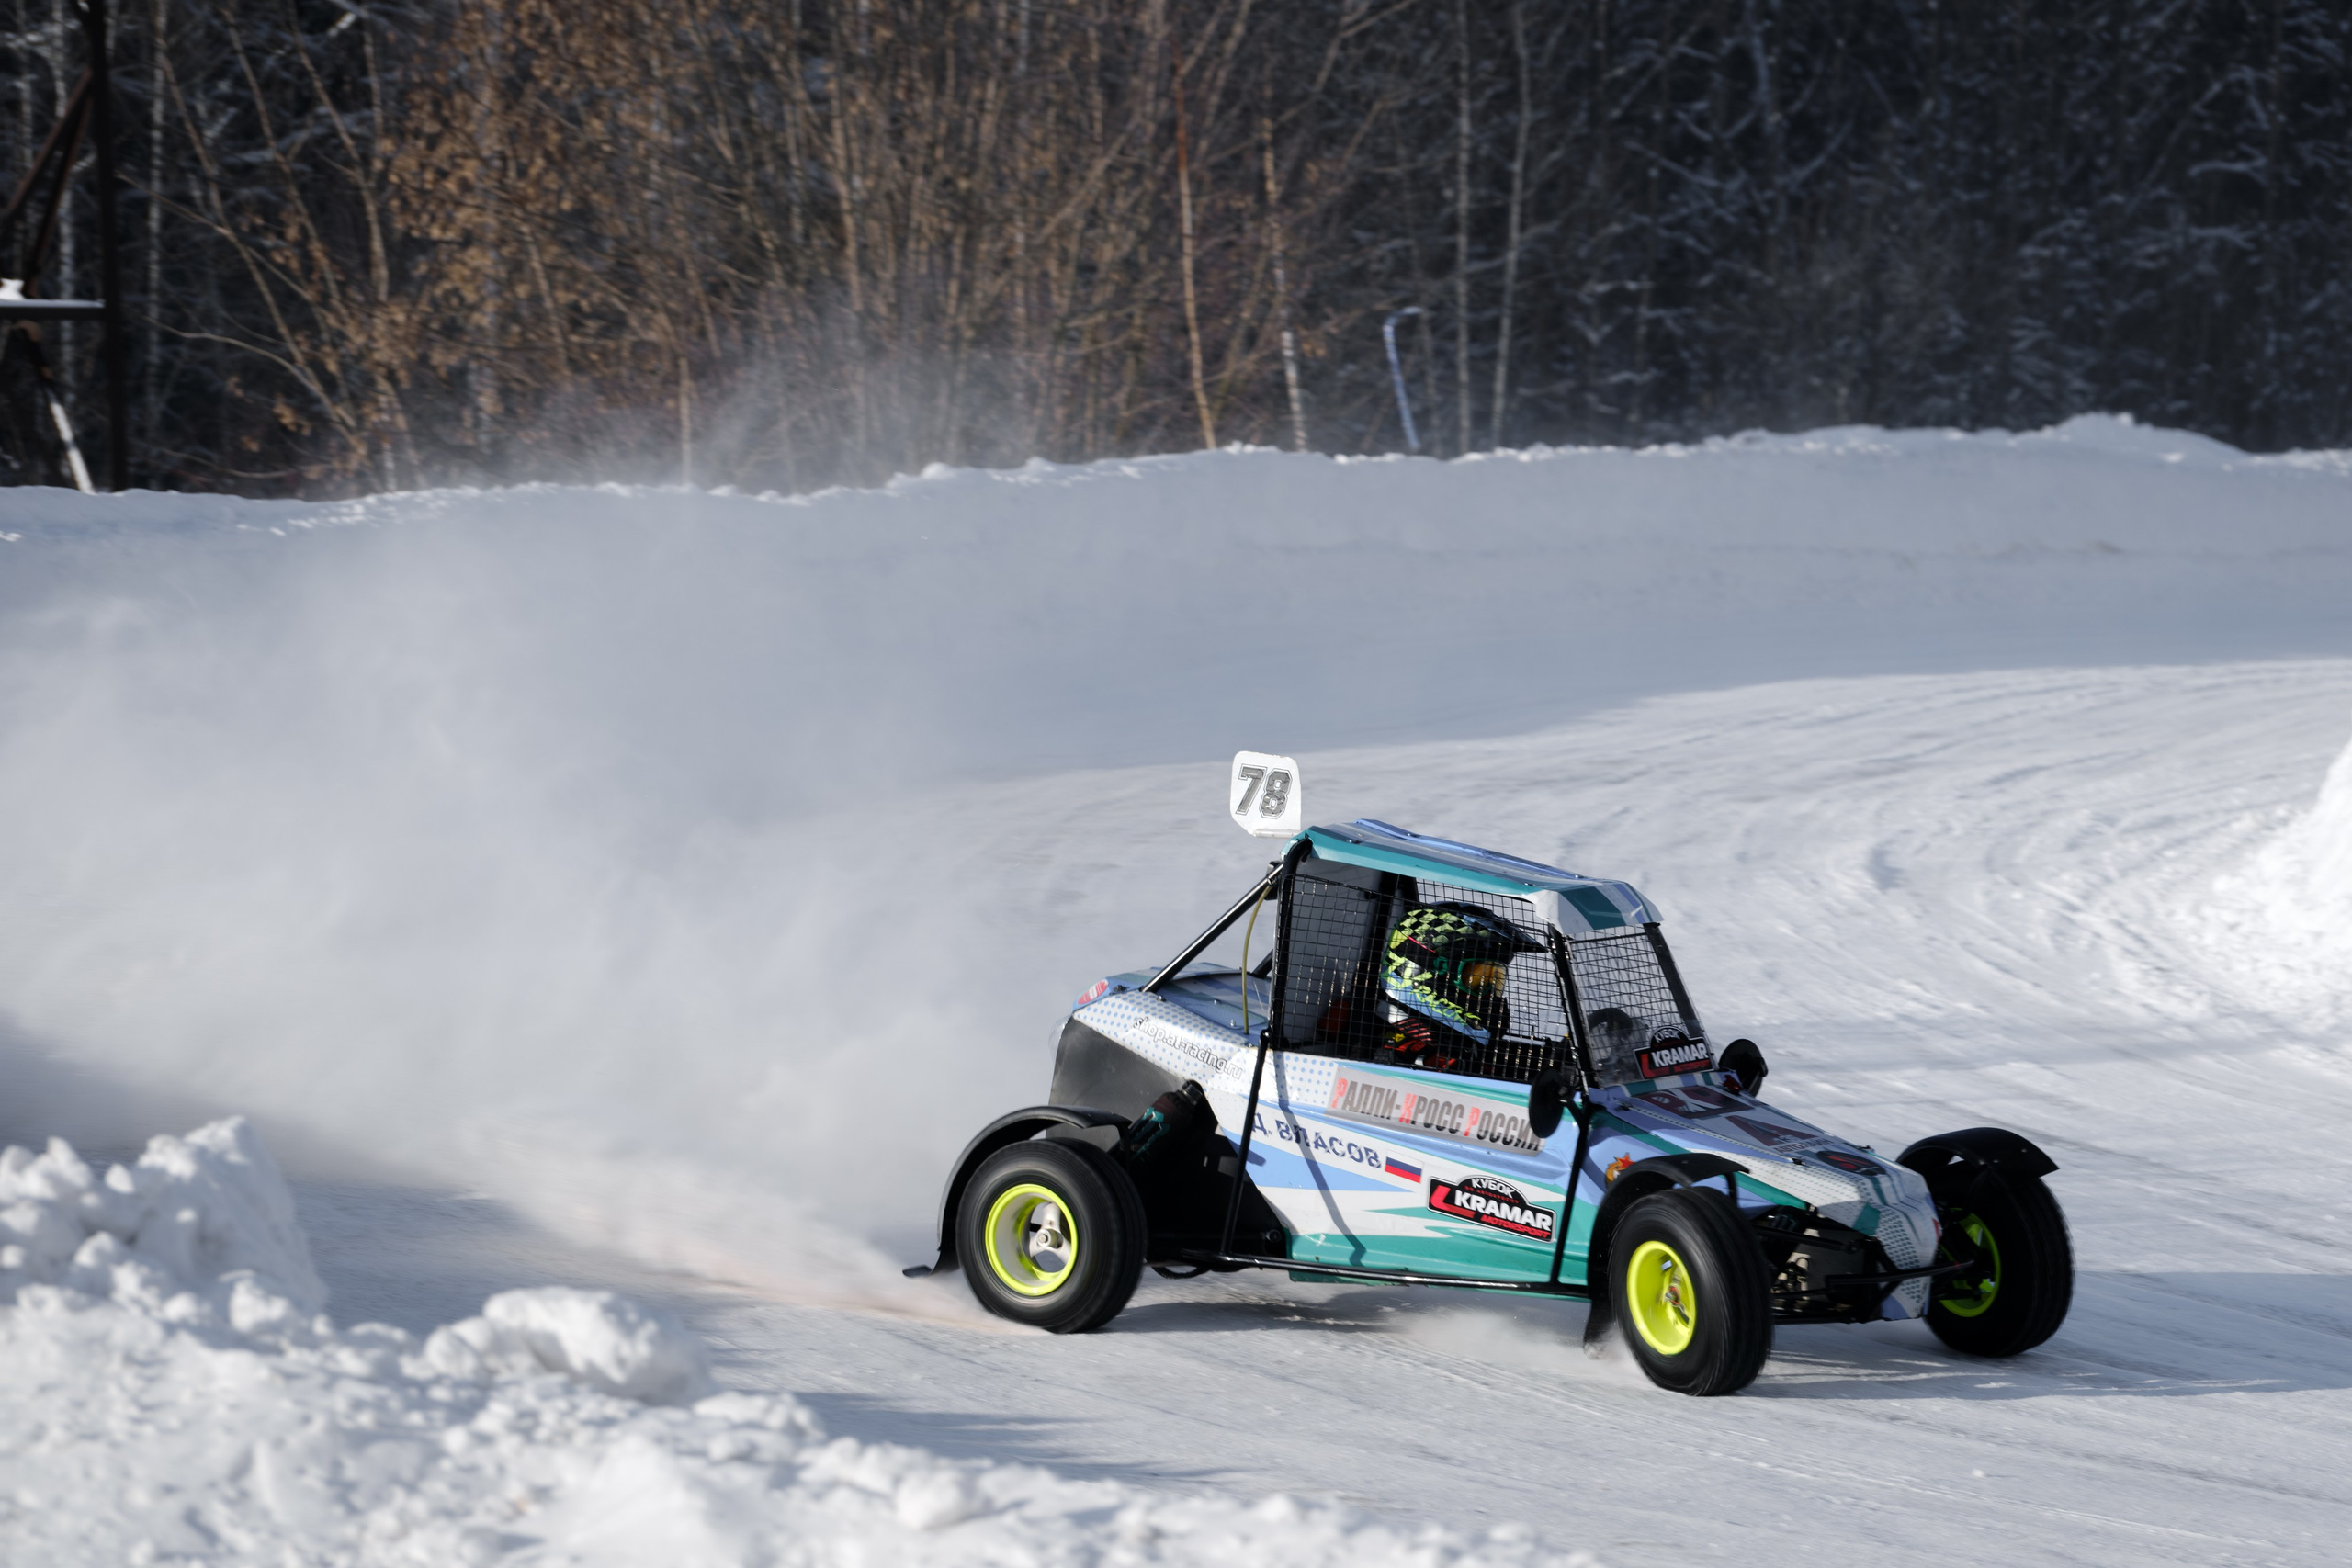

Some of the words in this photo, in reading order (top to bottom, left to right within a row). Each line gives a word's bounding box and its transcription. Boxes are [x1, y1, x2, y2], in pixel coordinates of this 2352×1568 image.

[1235, 763, 1293, 819] 78
[1132, 1015, 1243, 1080] shop.at-racing.ru
[1650, 1043, 1709, 1067] KRAMAR
[1274, 1119, 1382, 1168] ВЛАСОВ
[1471, 1177, 1516, 1199] КУБОК
[1454, 1189, 1552, 1232] KRAMAR
[1480, 1213, 1552, 1239] MOTORSPORT
